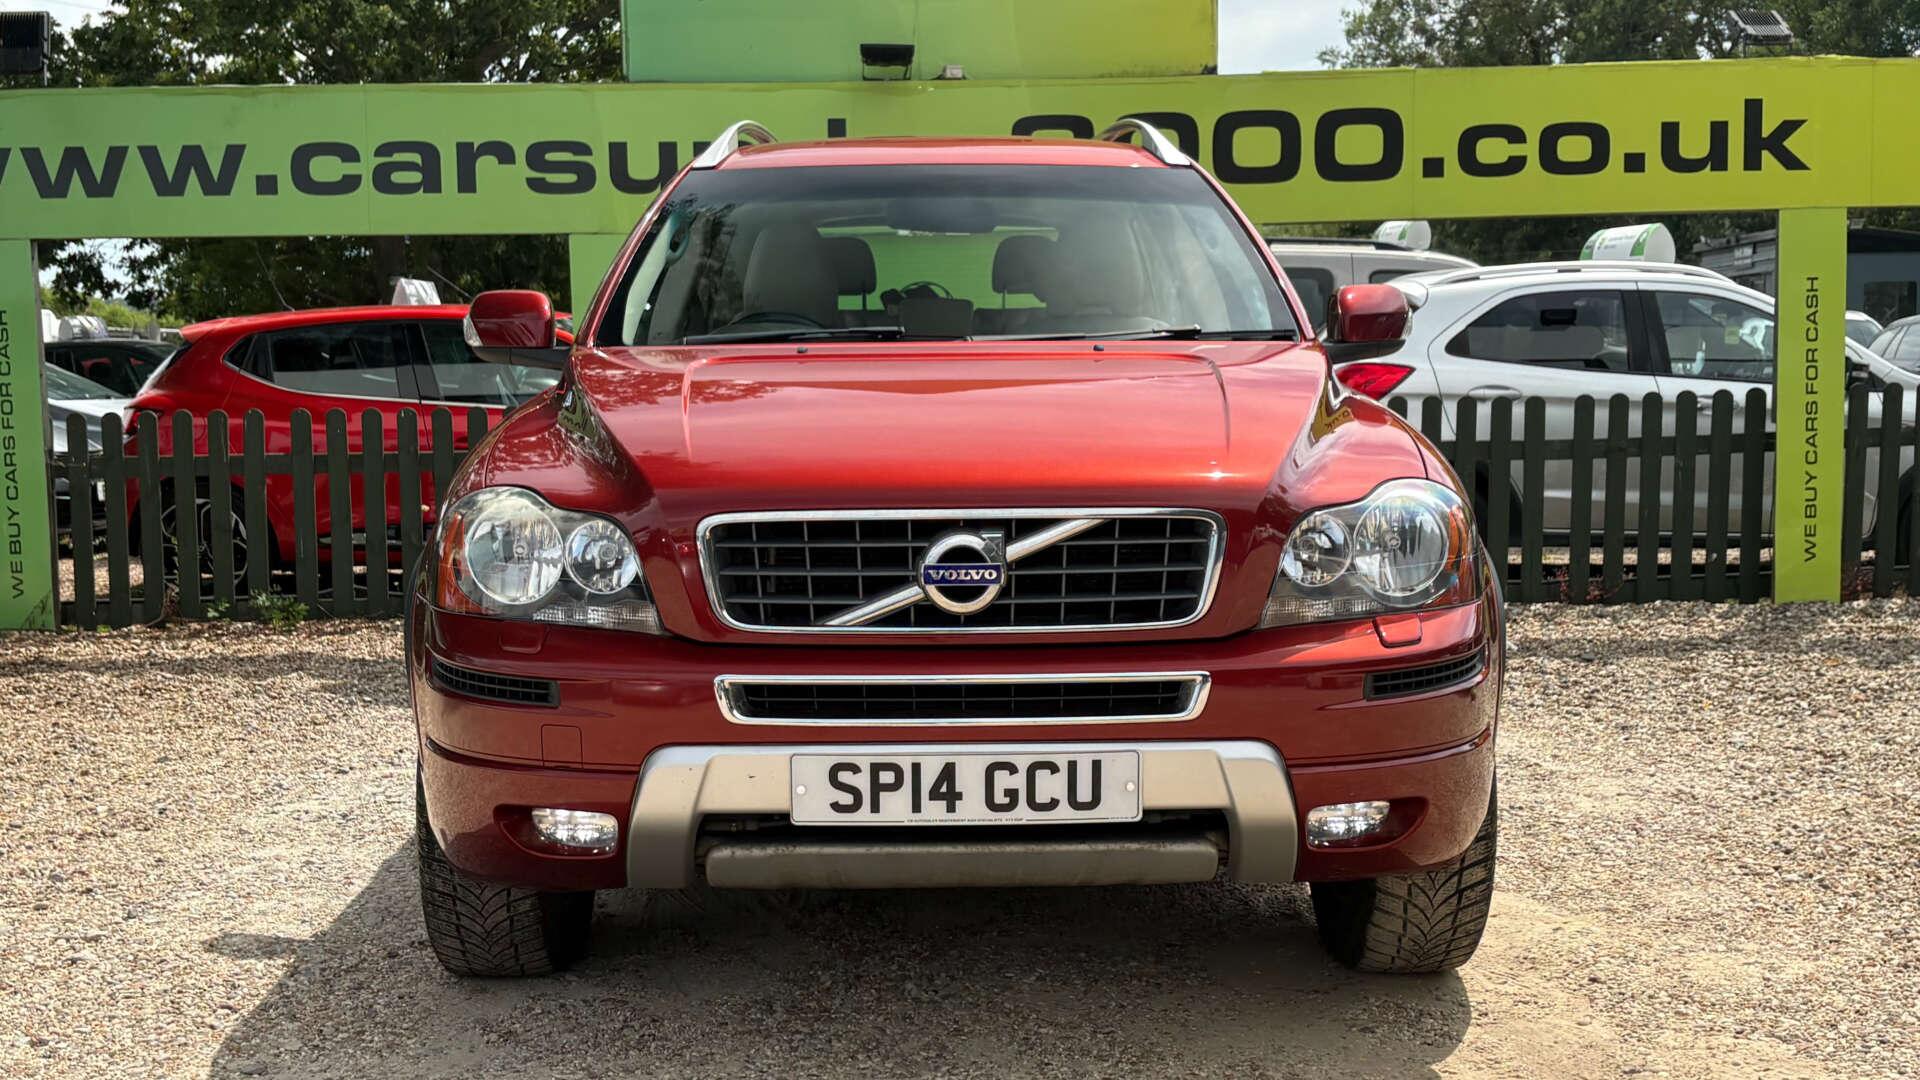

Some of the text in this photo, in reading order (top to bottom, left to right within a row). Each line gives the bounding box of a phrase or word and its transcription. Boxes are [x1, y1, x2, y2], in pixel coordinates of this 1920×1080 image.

[0, 382, 15, 430] FOR
[1804, 276, 1820, 562] WE BUY CARS FOR CASH
[3, 435, 19, 500] CARS
[7, 506, 22, 555] BUY
[10, 560, 25, 599] WE
[927, 569, 998, 581] VOLVO
[828, 759, 1102, 814] SP14 GCU
